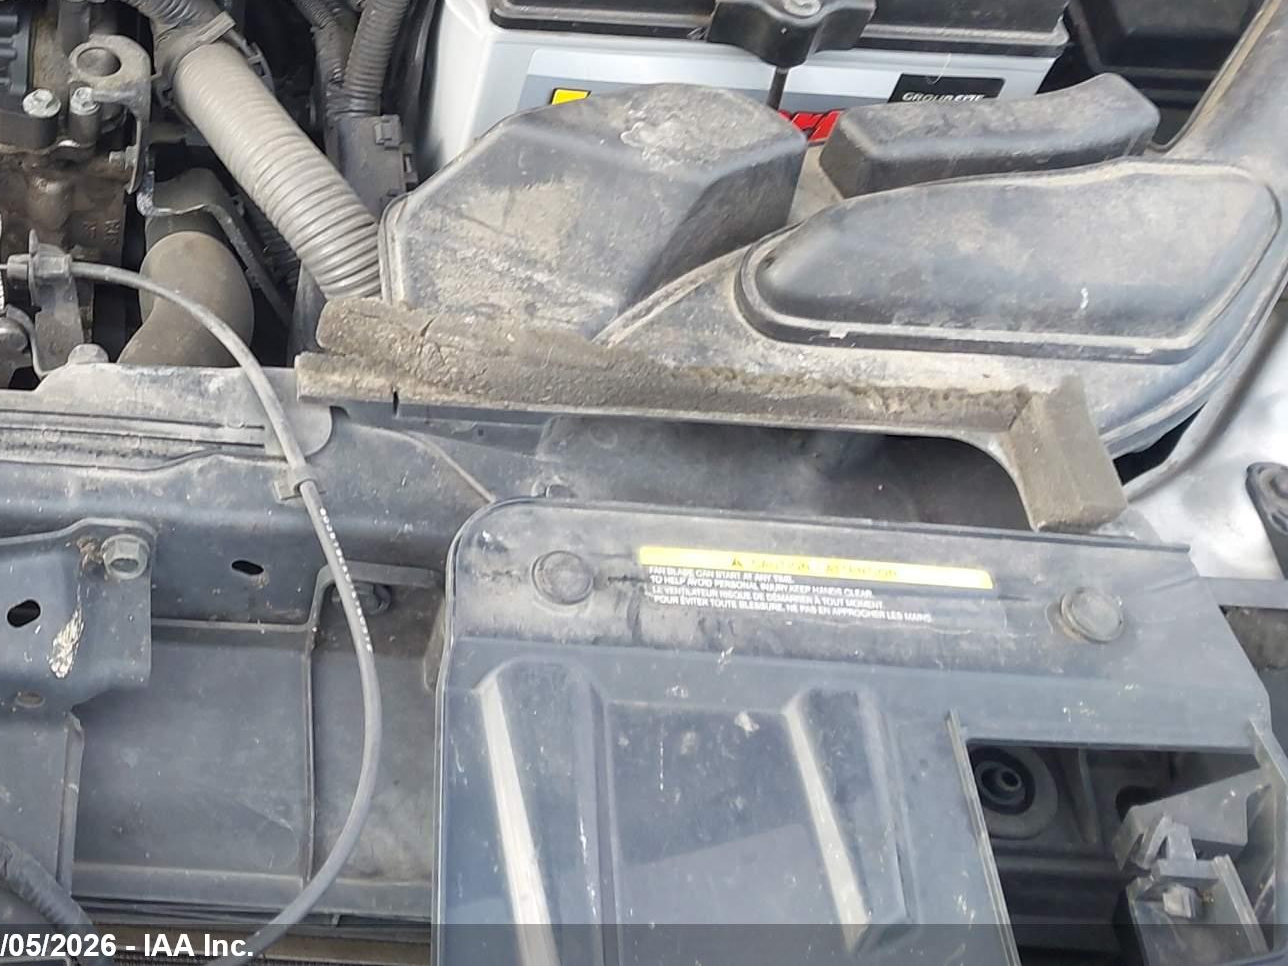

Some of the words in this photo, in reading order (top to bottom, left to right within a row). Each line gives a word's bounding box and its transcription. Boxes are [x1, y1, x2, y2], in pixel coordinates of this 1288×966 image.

[650, 575, 663, 584] TO
[664, 576, 686, 585] HELP
[687, 577, 713, 587] AVOID
[714, 579, 759, 591] PERSONAL
[789, 585, 811, 594] KEEP
[812, 586, 843, 597] HANDS
[696, 570, 714, 578] CAN
[715, 571, 741, 580] START
[753, 574, 771, 582] ANY
[665, 586, 718, 598] VENTILATEUR
[719, 590, 751, 600] RISQUE
[823, 598, 844, 607] TOUT
[654, 594, 680, 605] POUR
[709, 599, 738, 609] TOUTE
[799, 605, 817, 615] PAS
[832, 608, 885, 620] APPROCHER
[886, 612, 903, 621] LES
